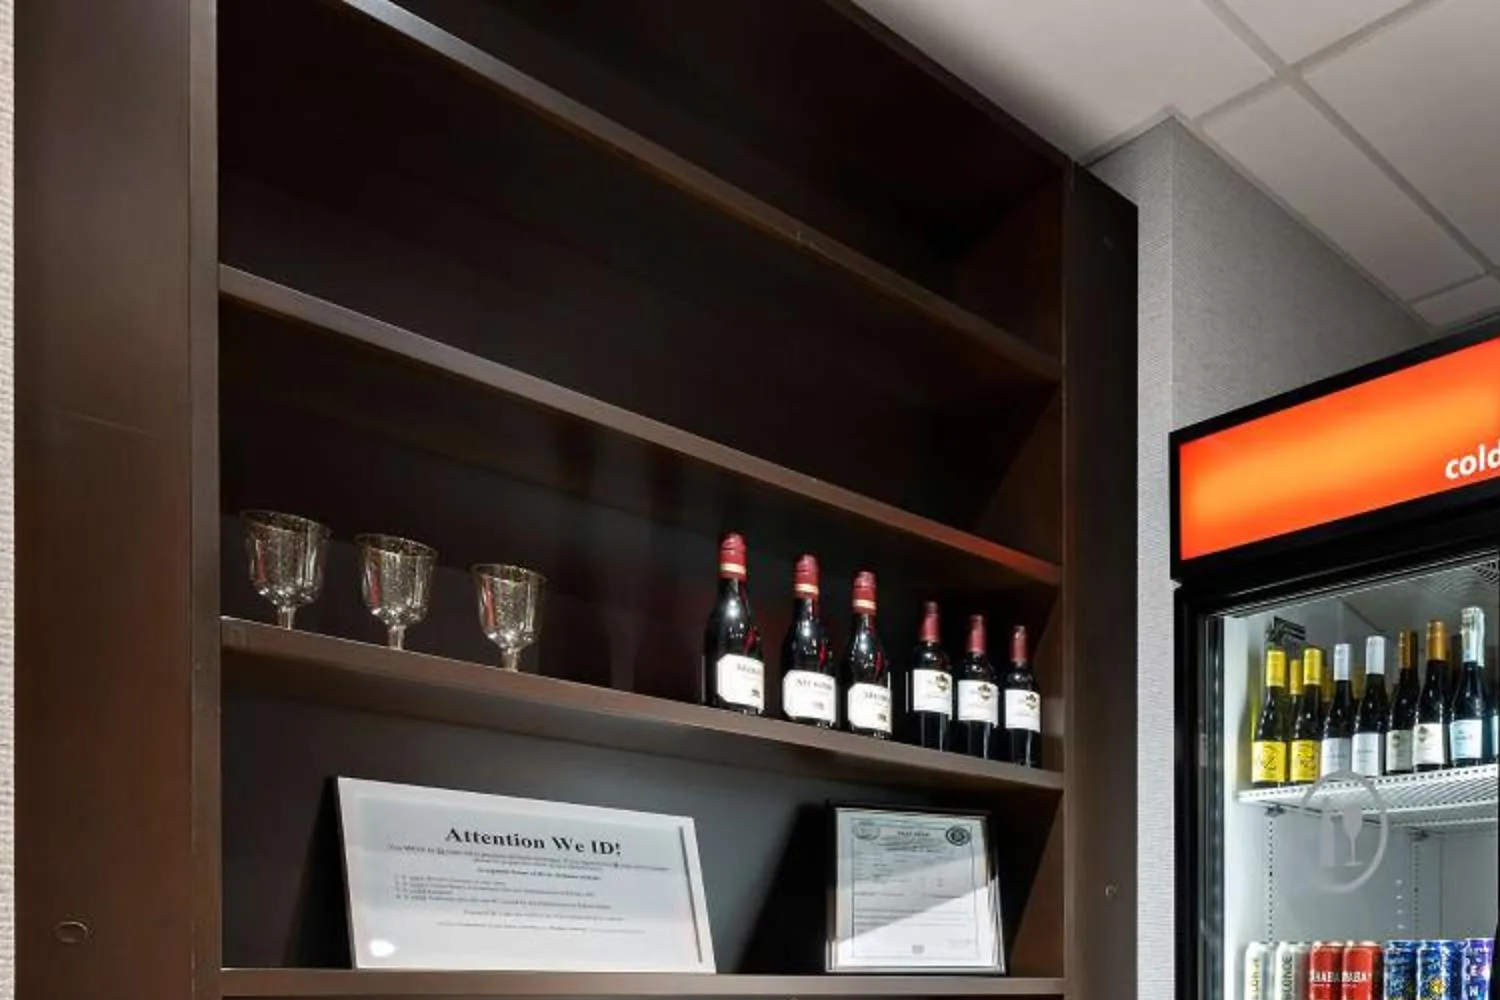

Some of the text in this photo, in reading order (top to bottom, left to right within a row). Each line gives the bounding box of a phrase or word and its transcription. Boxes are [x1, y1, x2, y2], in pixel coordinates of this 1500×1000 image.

[445, 827, 546, 850] Attention
[553, 836, 586, 853] We
[591, 838, 622, 856] ID!
